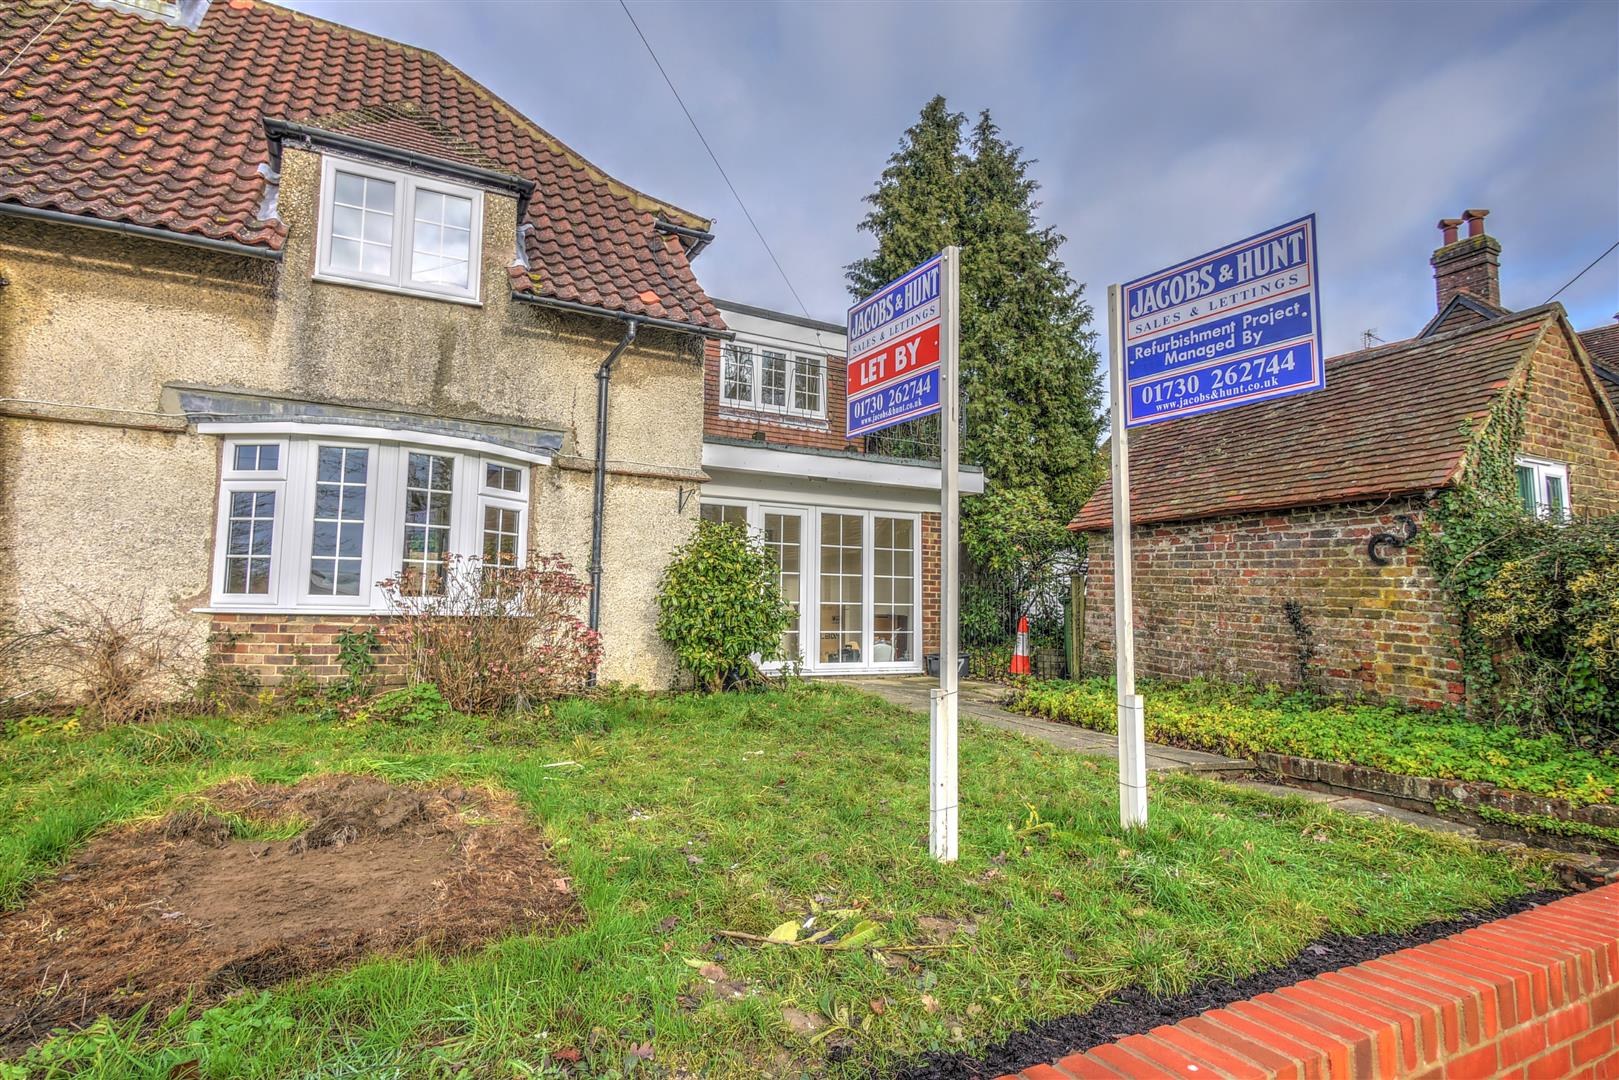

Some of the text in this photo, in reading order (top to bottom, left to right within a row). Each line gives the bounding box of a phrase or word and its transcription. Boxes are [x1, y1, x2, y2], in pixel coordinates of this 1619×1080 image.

[1131, 232, 1303, 317] JACOBS & HUNT
[851, 267, 939, 340] JACOBS & HUNT
[1136, 273, 1299, 333] SALES & LETTINGS
[853, 306, 935, 354] SALES & LETTINGS
[1136, 302, 1300, 359] Refurbishment Project
[1165, 331, 1263, 365] Managed By
[860, 336, 921, 386] LET BY
[1142, 351, 1295, 404] 01730 262744
[855, 375, 930, 419] 01730 262744
[1156, 376, 1278, 412] www.jacobs&hunt.co.uk
